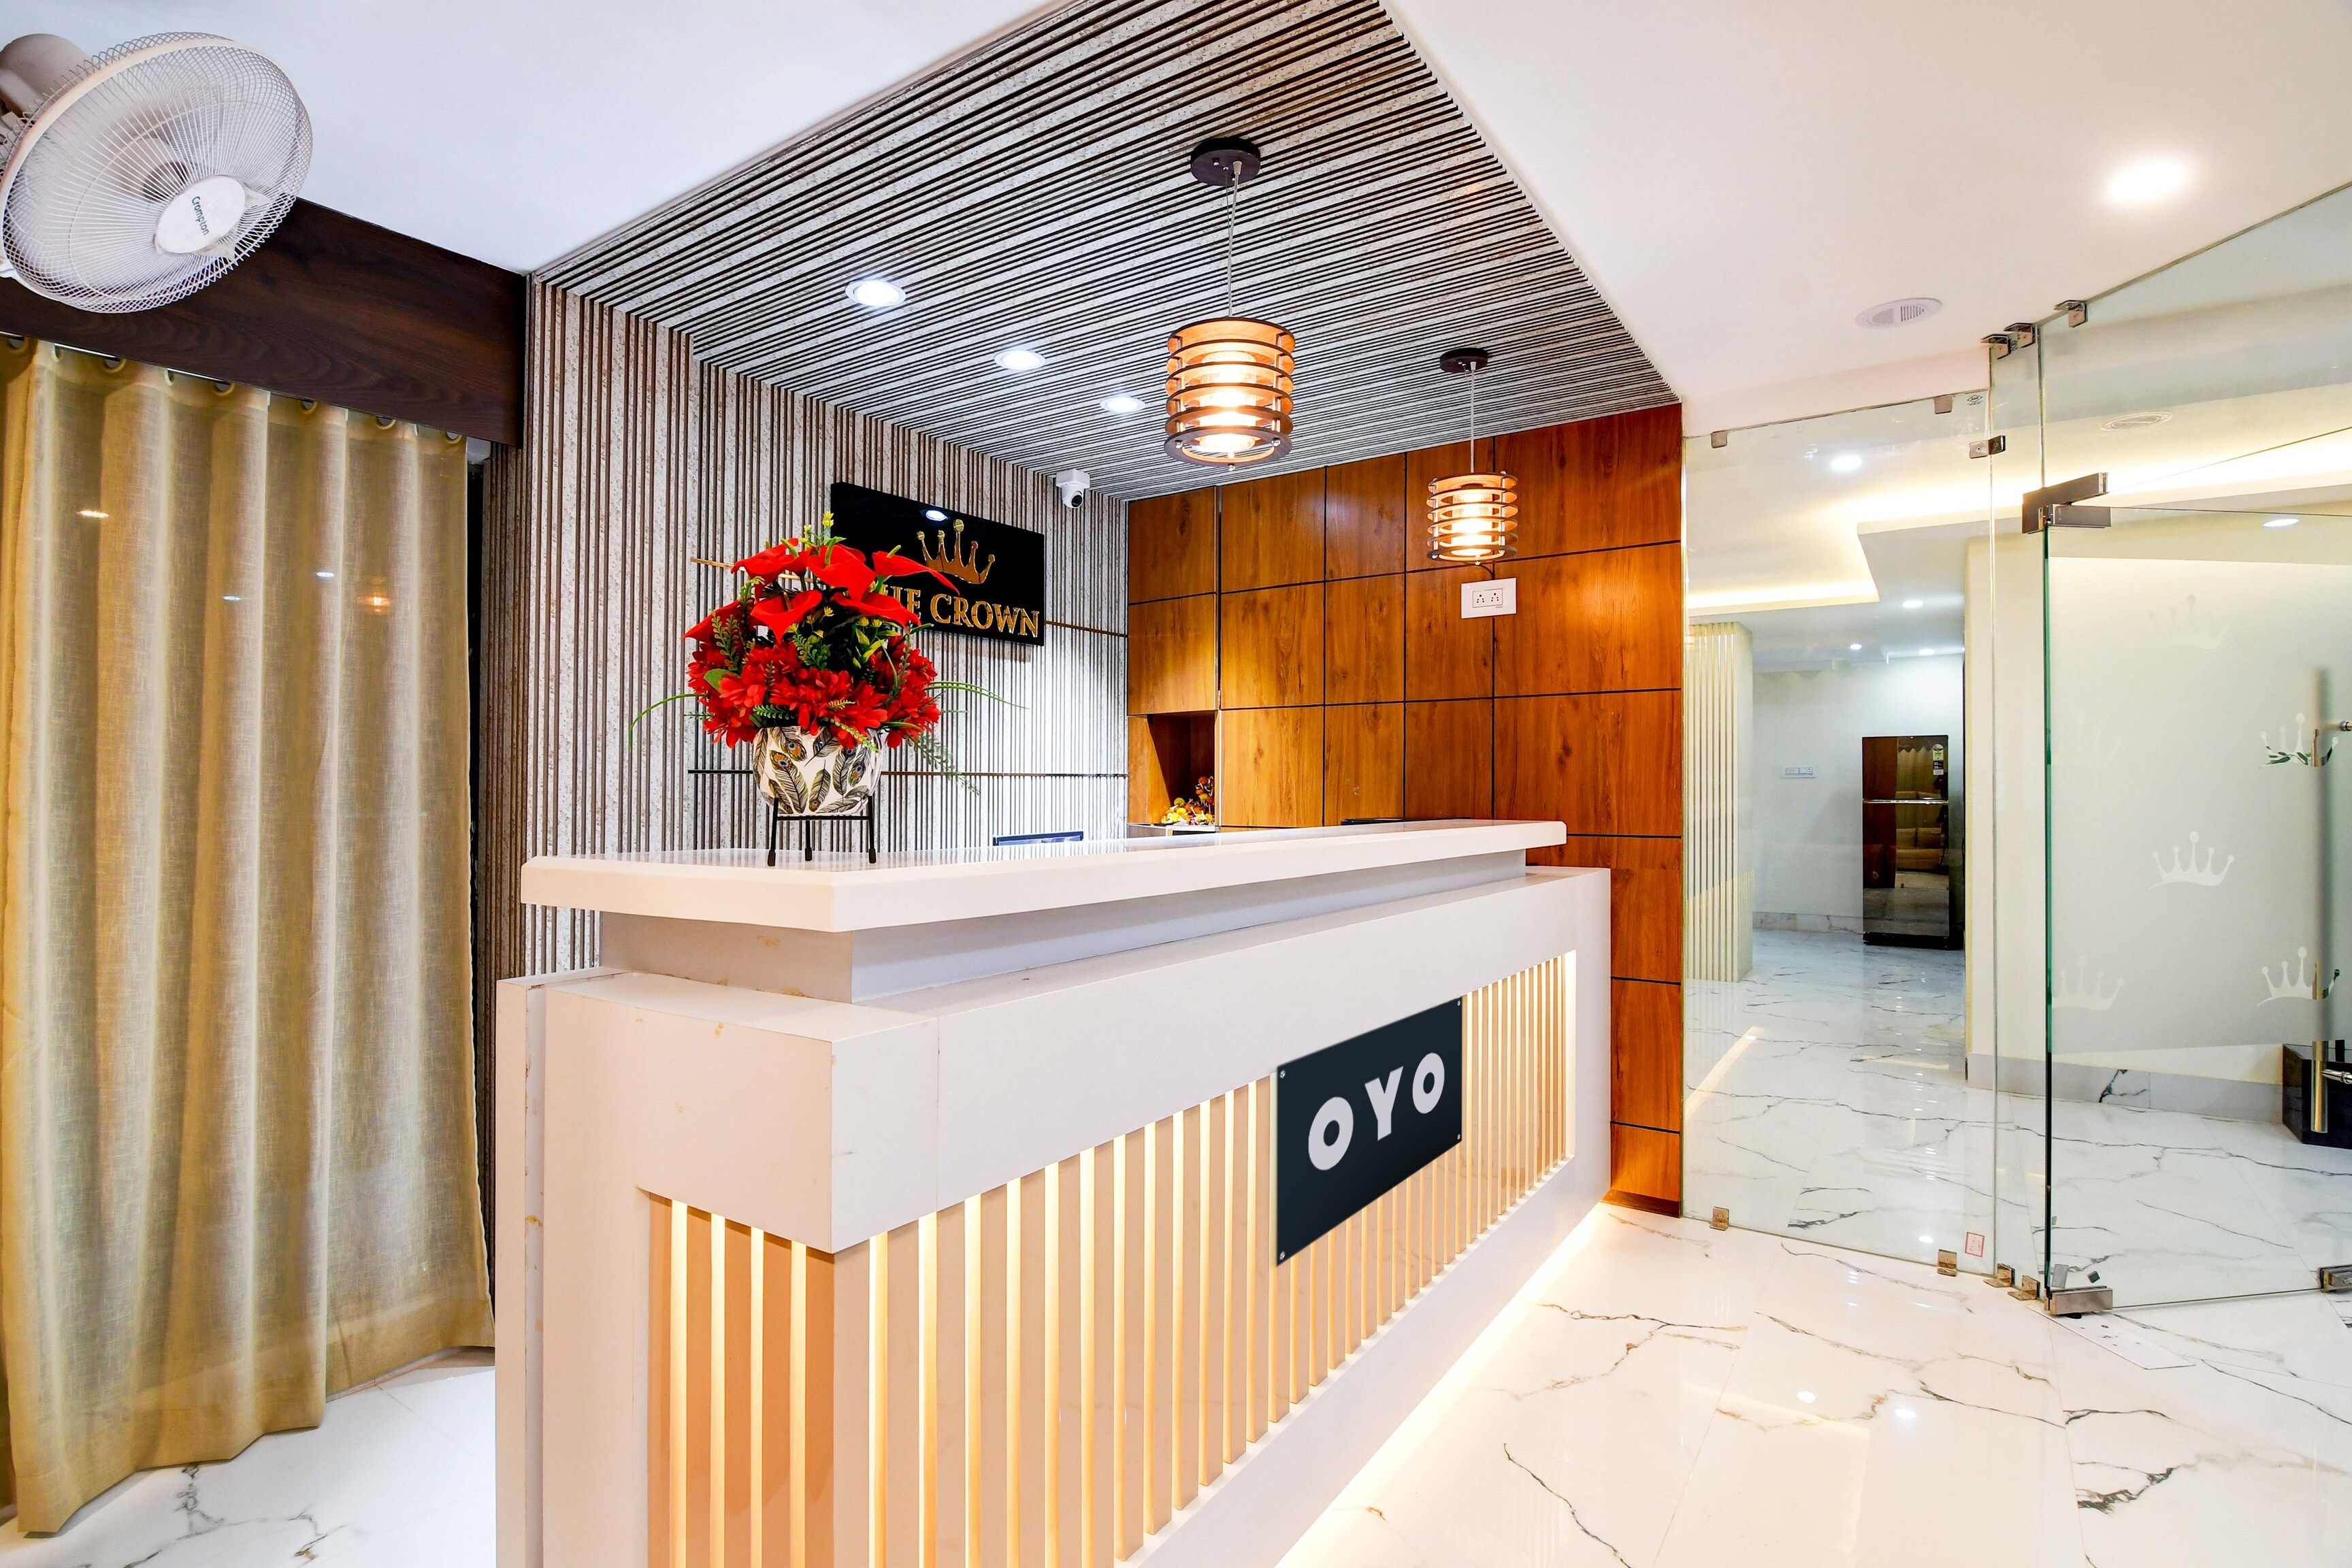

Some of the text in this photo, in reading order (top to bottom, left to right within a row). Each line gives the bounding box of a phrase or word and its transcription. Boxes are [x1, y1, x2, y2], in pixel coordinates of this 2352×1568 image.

[192, 196, 210, 235] Crompton
[930, 593, 1039, 638] CROWN
[1308, 1052, 1445, 1171] OYO
